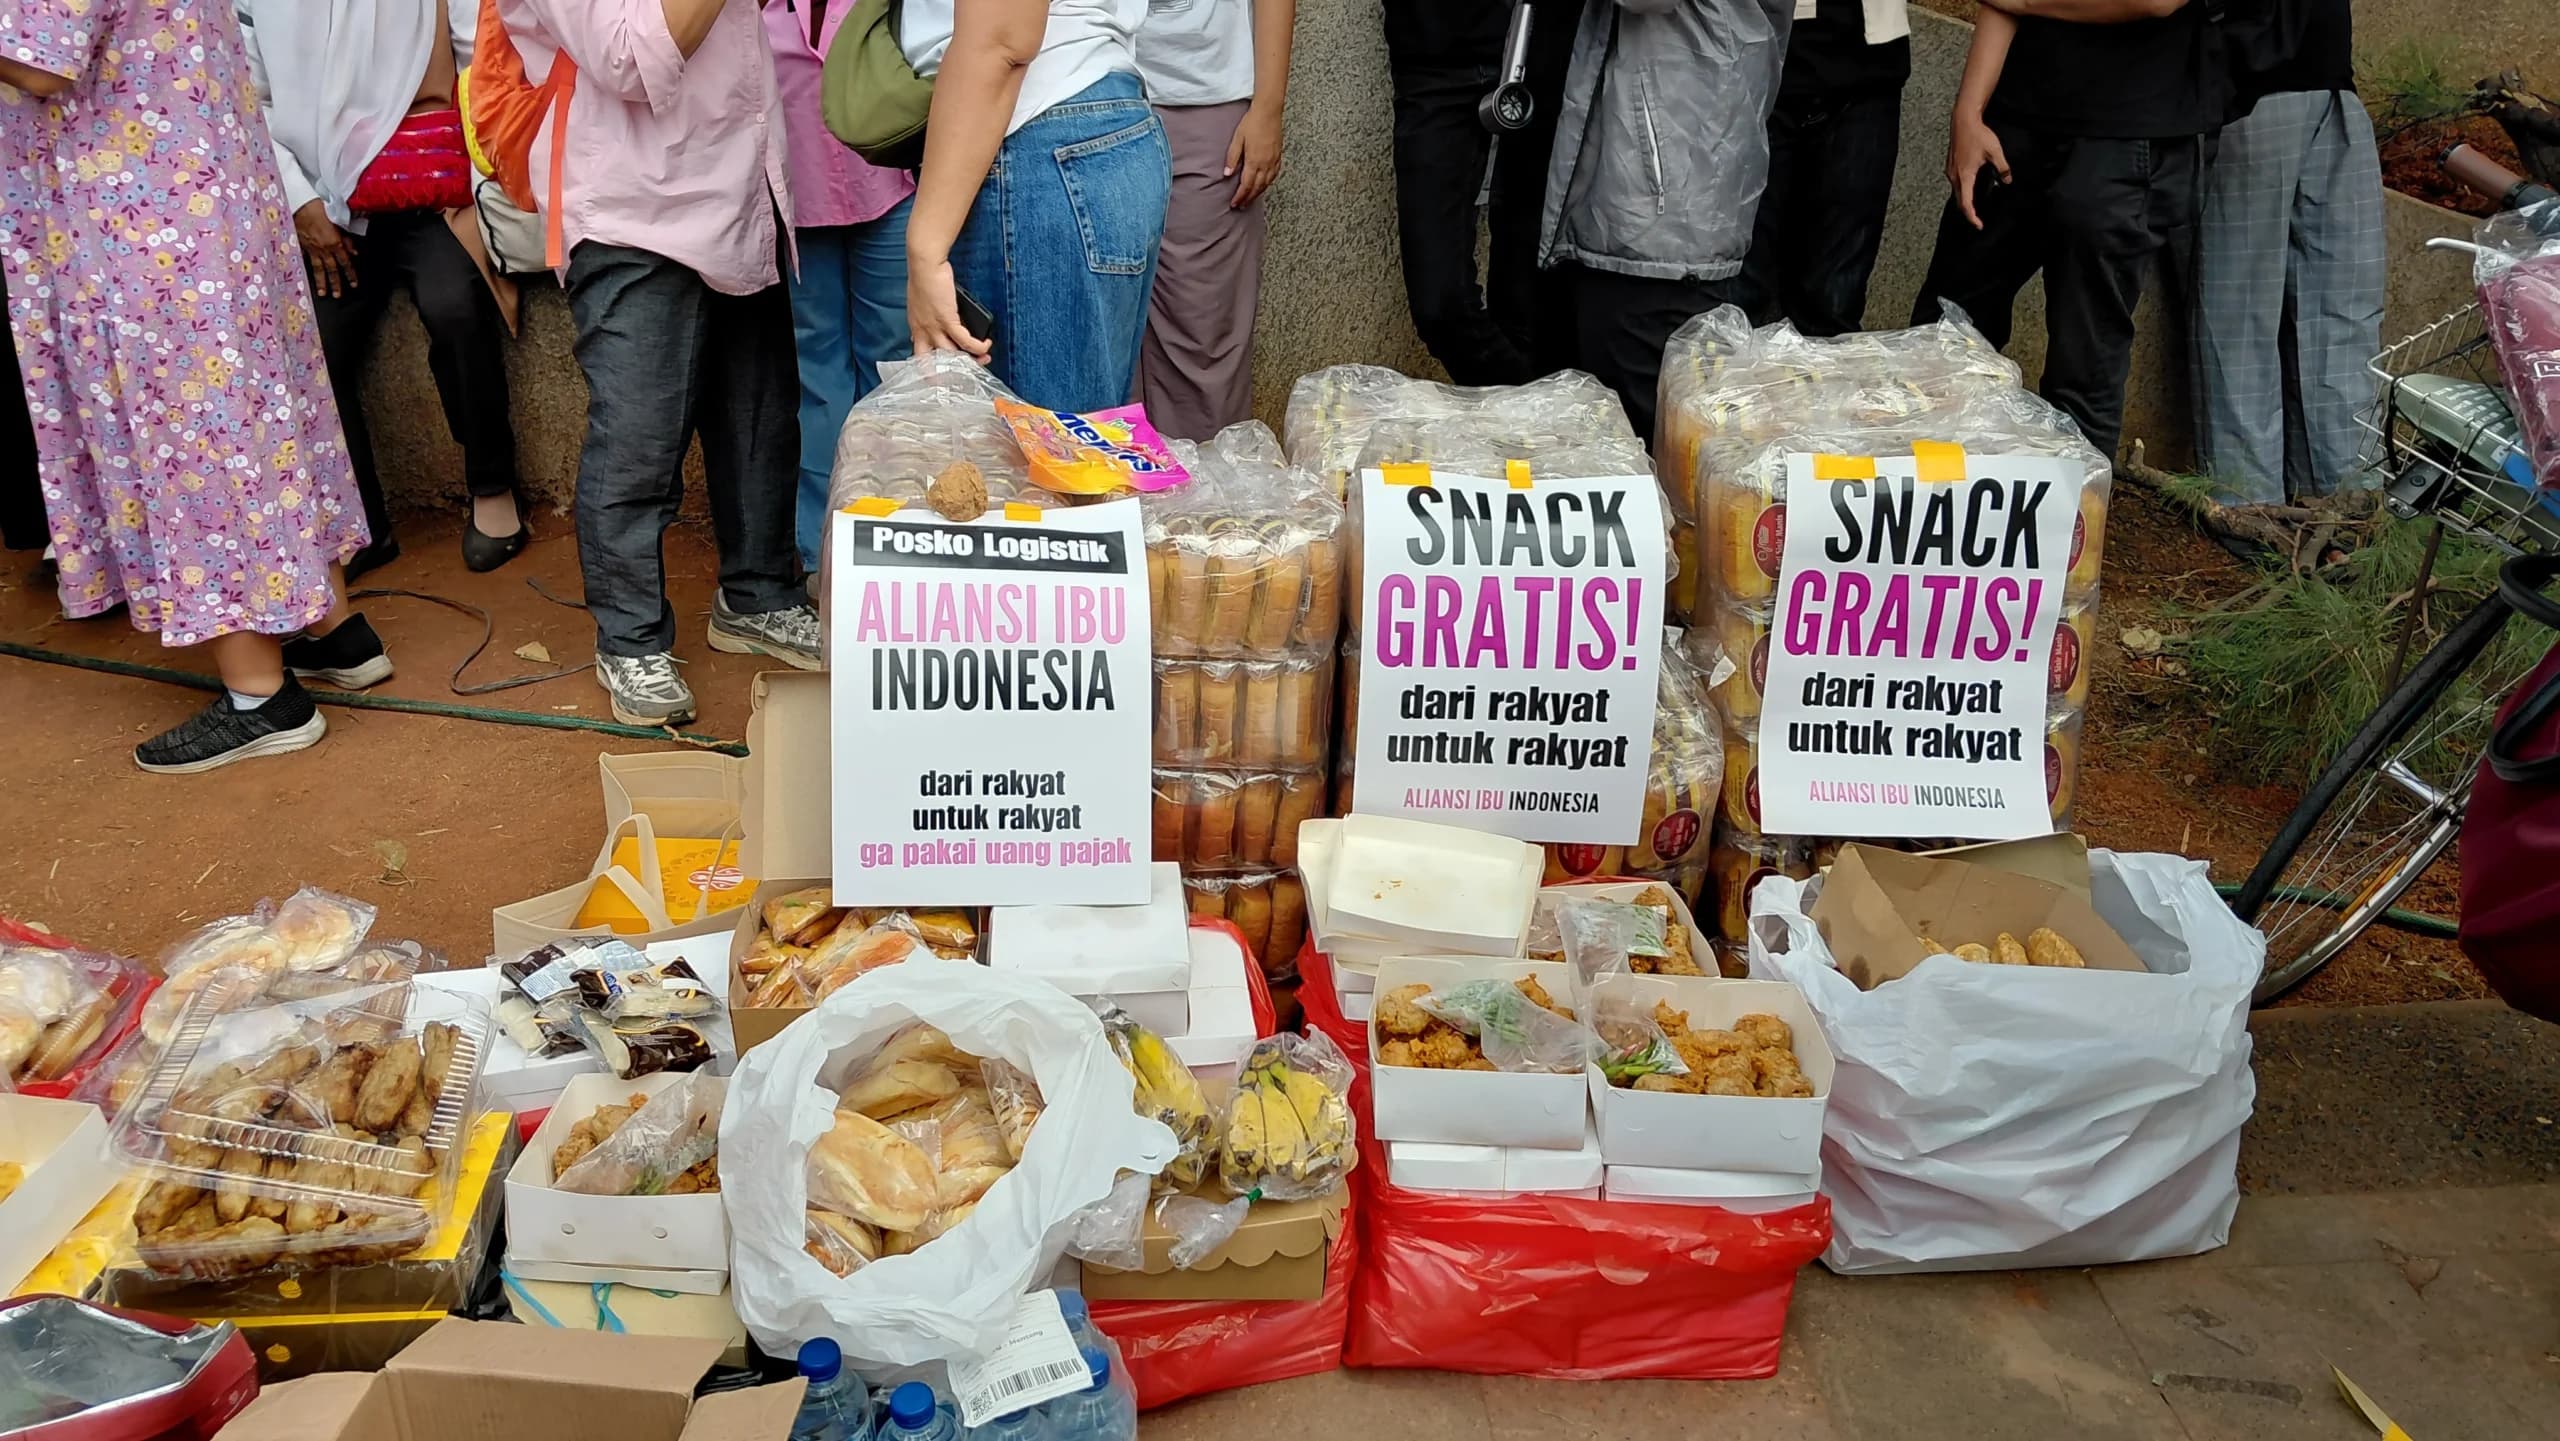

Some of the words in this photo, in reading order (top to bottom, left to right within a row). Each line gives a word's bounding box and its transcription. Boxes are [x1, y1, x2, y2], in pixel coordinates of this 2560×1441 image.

[1407, 486, 1635, 567] SNACK
[1825, 477, 2051, 569] SNACK
[873, 526, 972, 557] Posko
[983, 532, 1109, 562] Logistik
[857, 582, 1036, 643] ALIANSI
[1056, 587, 1125, 643] IBU
[1376, 574, 1642, 671] GRATIS!
[1783, 569, 2044, 663] GRATIS!
[873, 649, 1114, 710] INDONESIA
[1802, 672, 1874, 708] dari
[1887, 676, 2002, 715] rakyat
[1401, 685, 1475, 719] dari
[1488, 687, 1609, 725] rakyat
[1388, 731, 1494, 764] untuk
[1508, 733, 1628, 770] rakyat
[1789, 720, 1892, 755] untuk
[1907, 723, 2021, 763] rakyat
[921, 770, 972, 796] dari
[983, 770, 1065, 798] rakyat
[1403, 788, 1470, 809] ALIANSI
[1475, 790, 1504, 810] IBU
[1509, 791, 1598, 813] INDONESIA
[1810, 781, 1875, 803] ALIANSI
[1881, 784, 1909, 805] IBU
[1915, 786, 2005, 808] INDONESIA
[913, 805, 988, 830] untuk
[999, 804, 1080, 832] rakyat
[861, 844, 893, 868] ga
[903, 840, 976, 868] pakai
[987, 843, 1051, 866] uang
[1060, 840, 1130, 865] pajak
